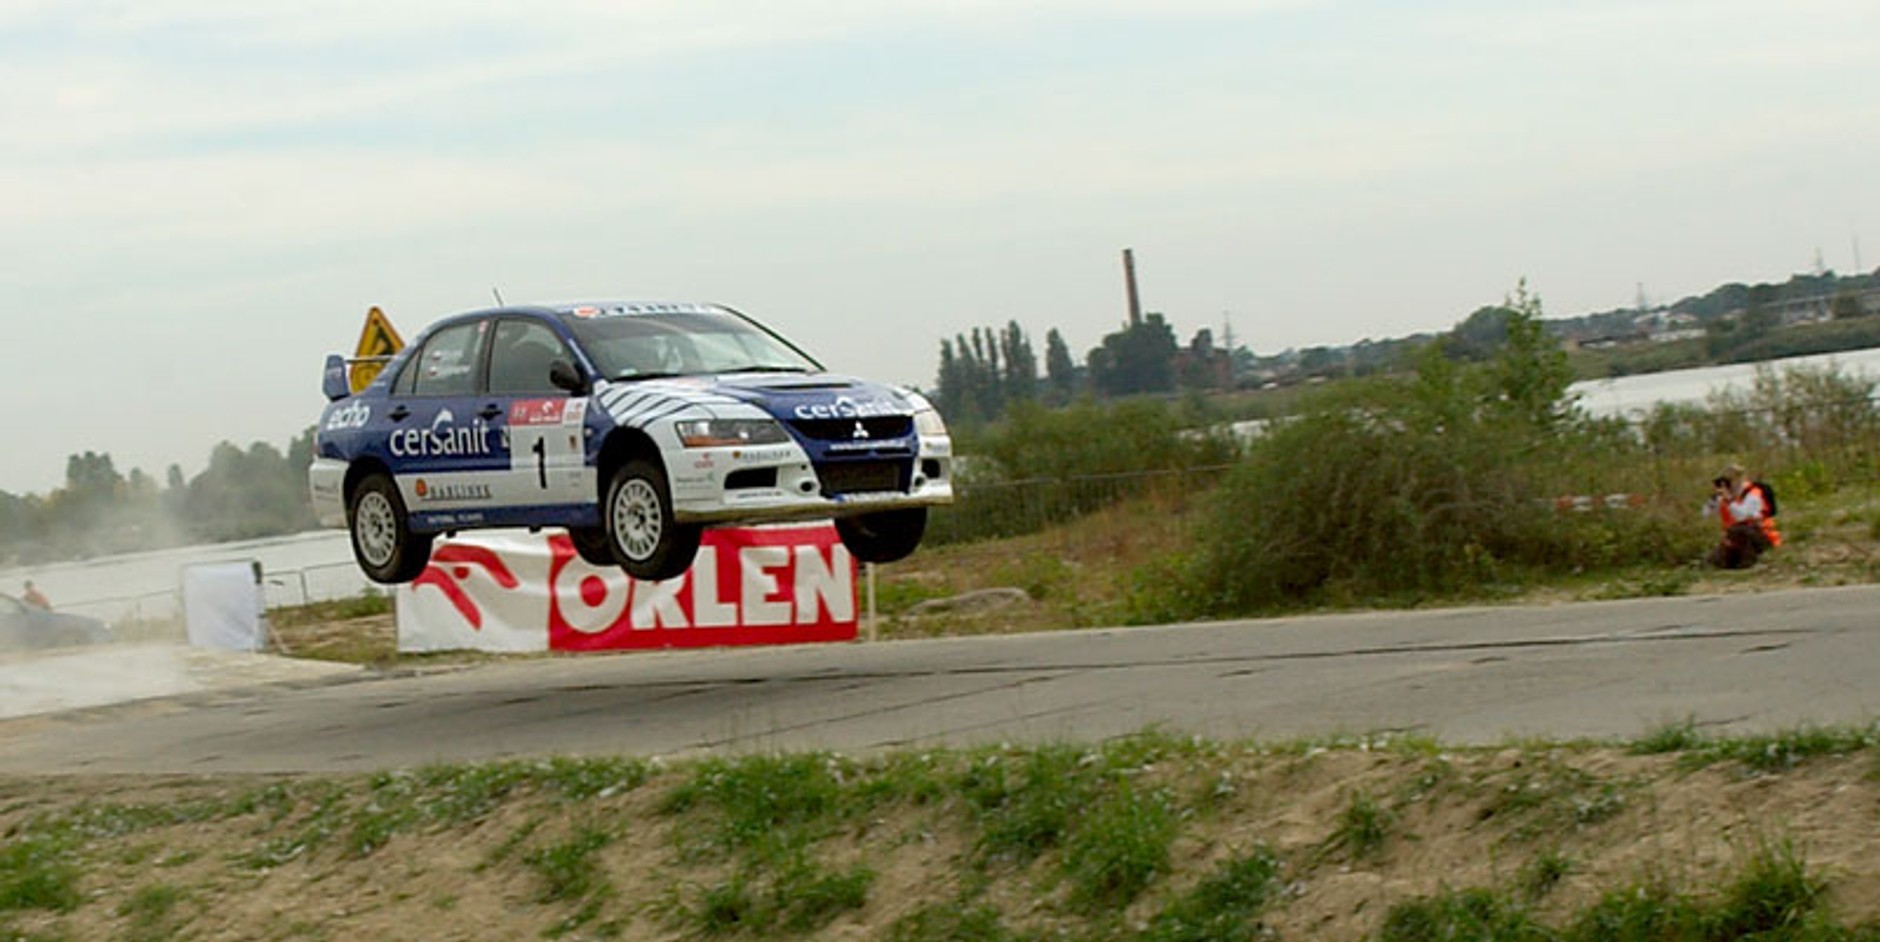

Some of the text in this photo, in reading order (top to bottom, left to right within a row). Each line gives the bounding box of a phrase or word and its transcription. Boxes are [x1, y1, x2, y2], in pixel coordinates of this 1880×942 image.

[327, 401, 370, 430] echo
[389, 410, 491, 456] cersanit
[532, 435, 548, 490] 1
[554, 543, 854, 634] ORLEN
